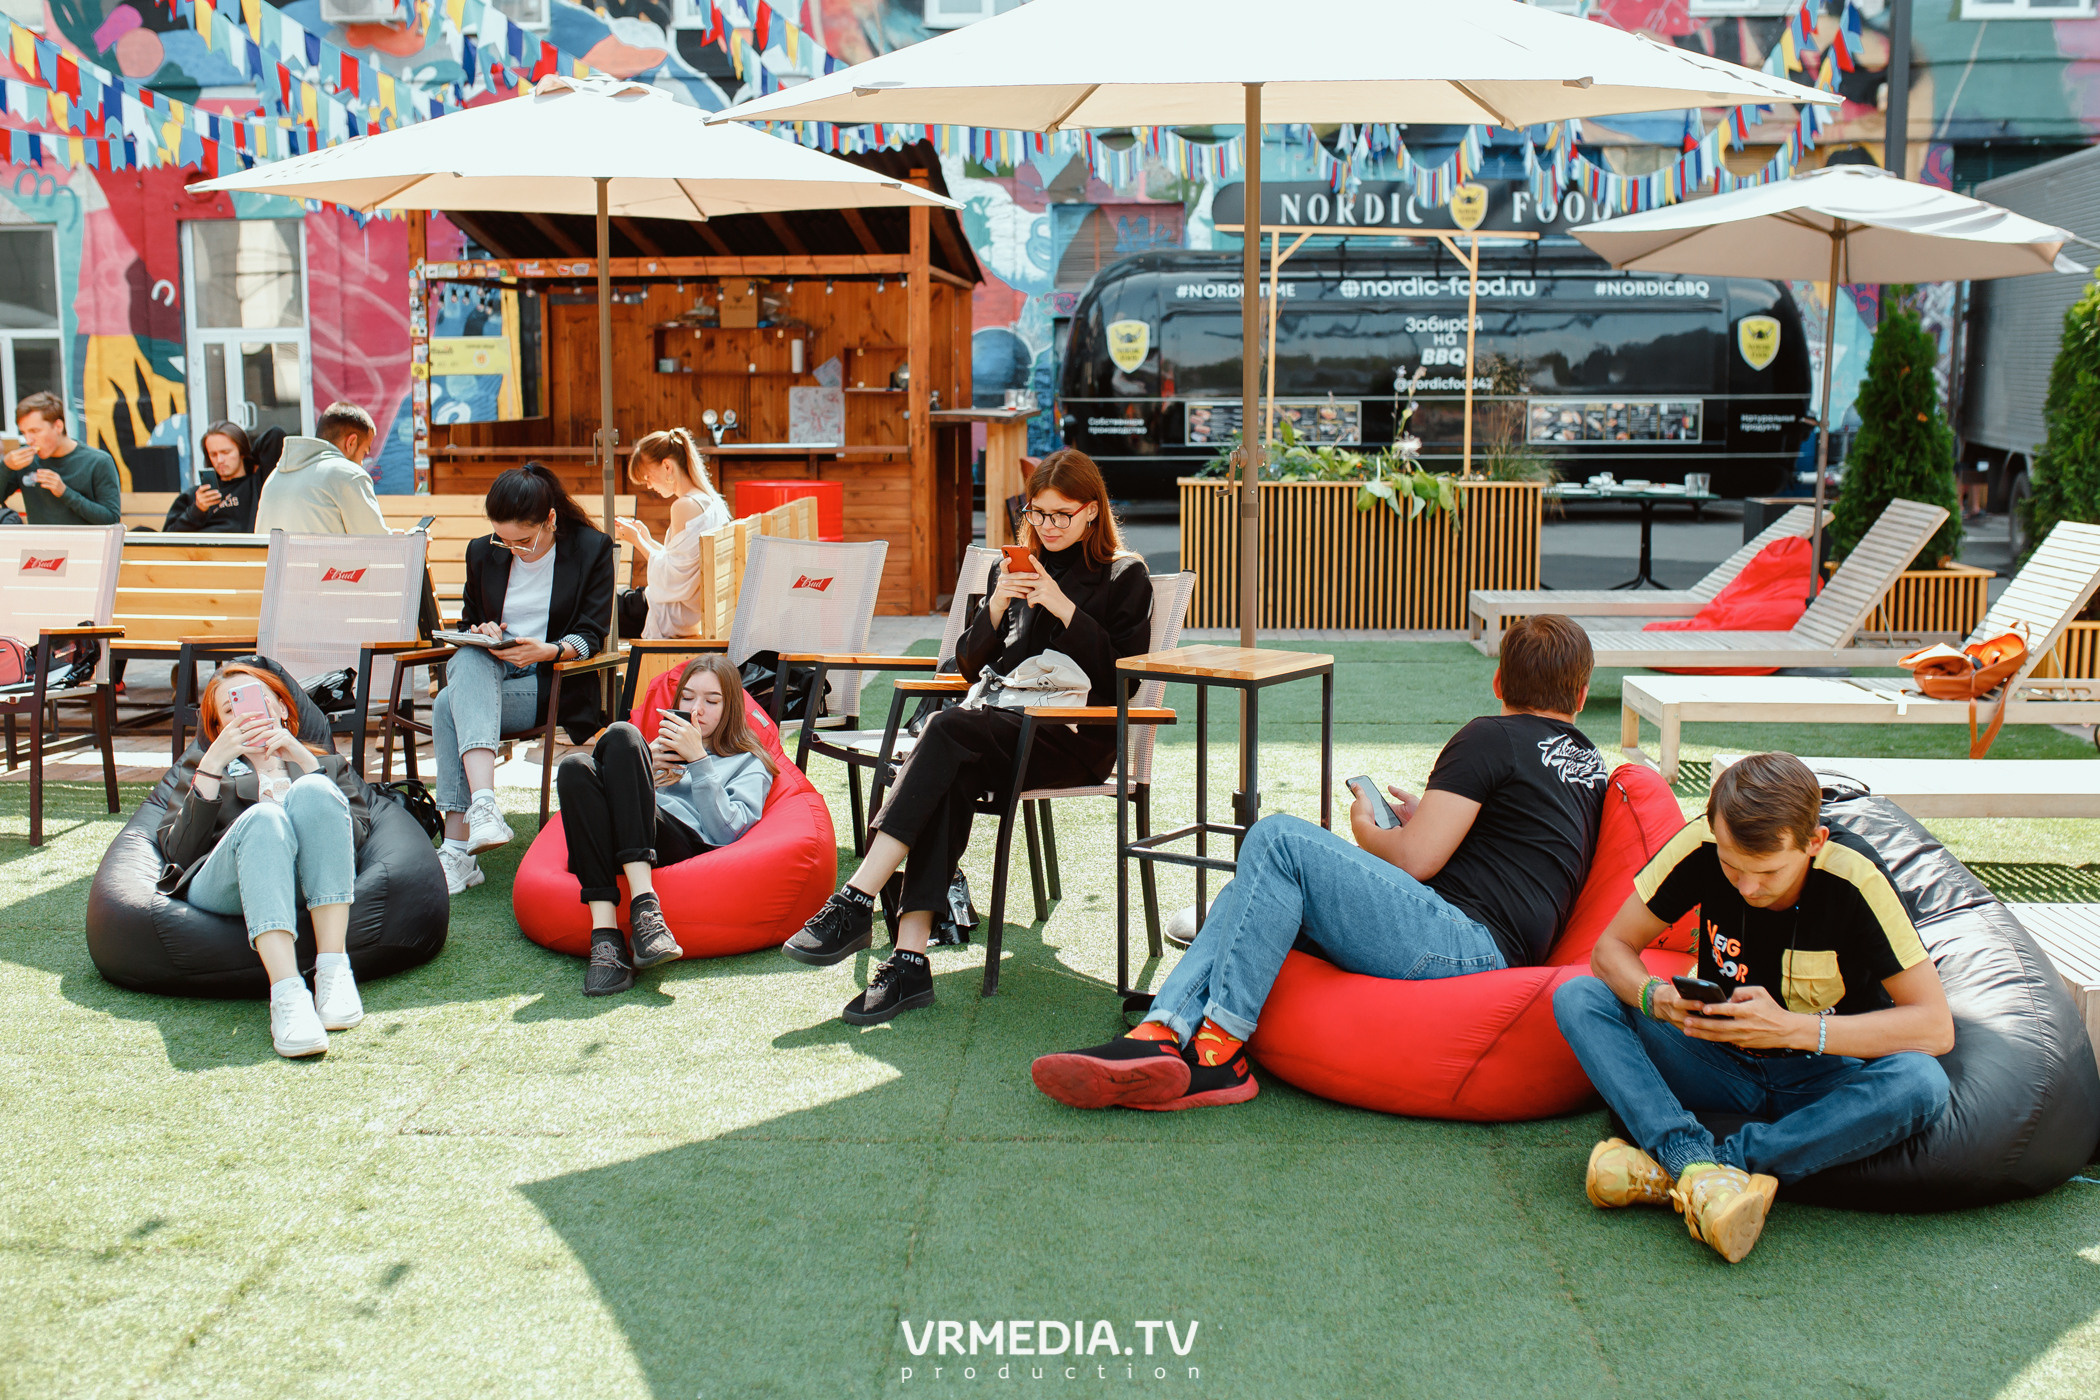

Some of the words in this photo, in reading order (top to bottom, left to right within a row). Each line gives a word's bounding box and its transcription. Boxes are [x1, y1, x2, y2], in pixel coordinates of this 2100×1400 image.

[1280, 192, 1425, 226] NORDIC
[1594, 280, 1710, 299] #NORDICBBQ
[1433, 333, 1458, 347] на
